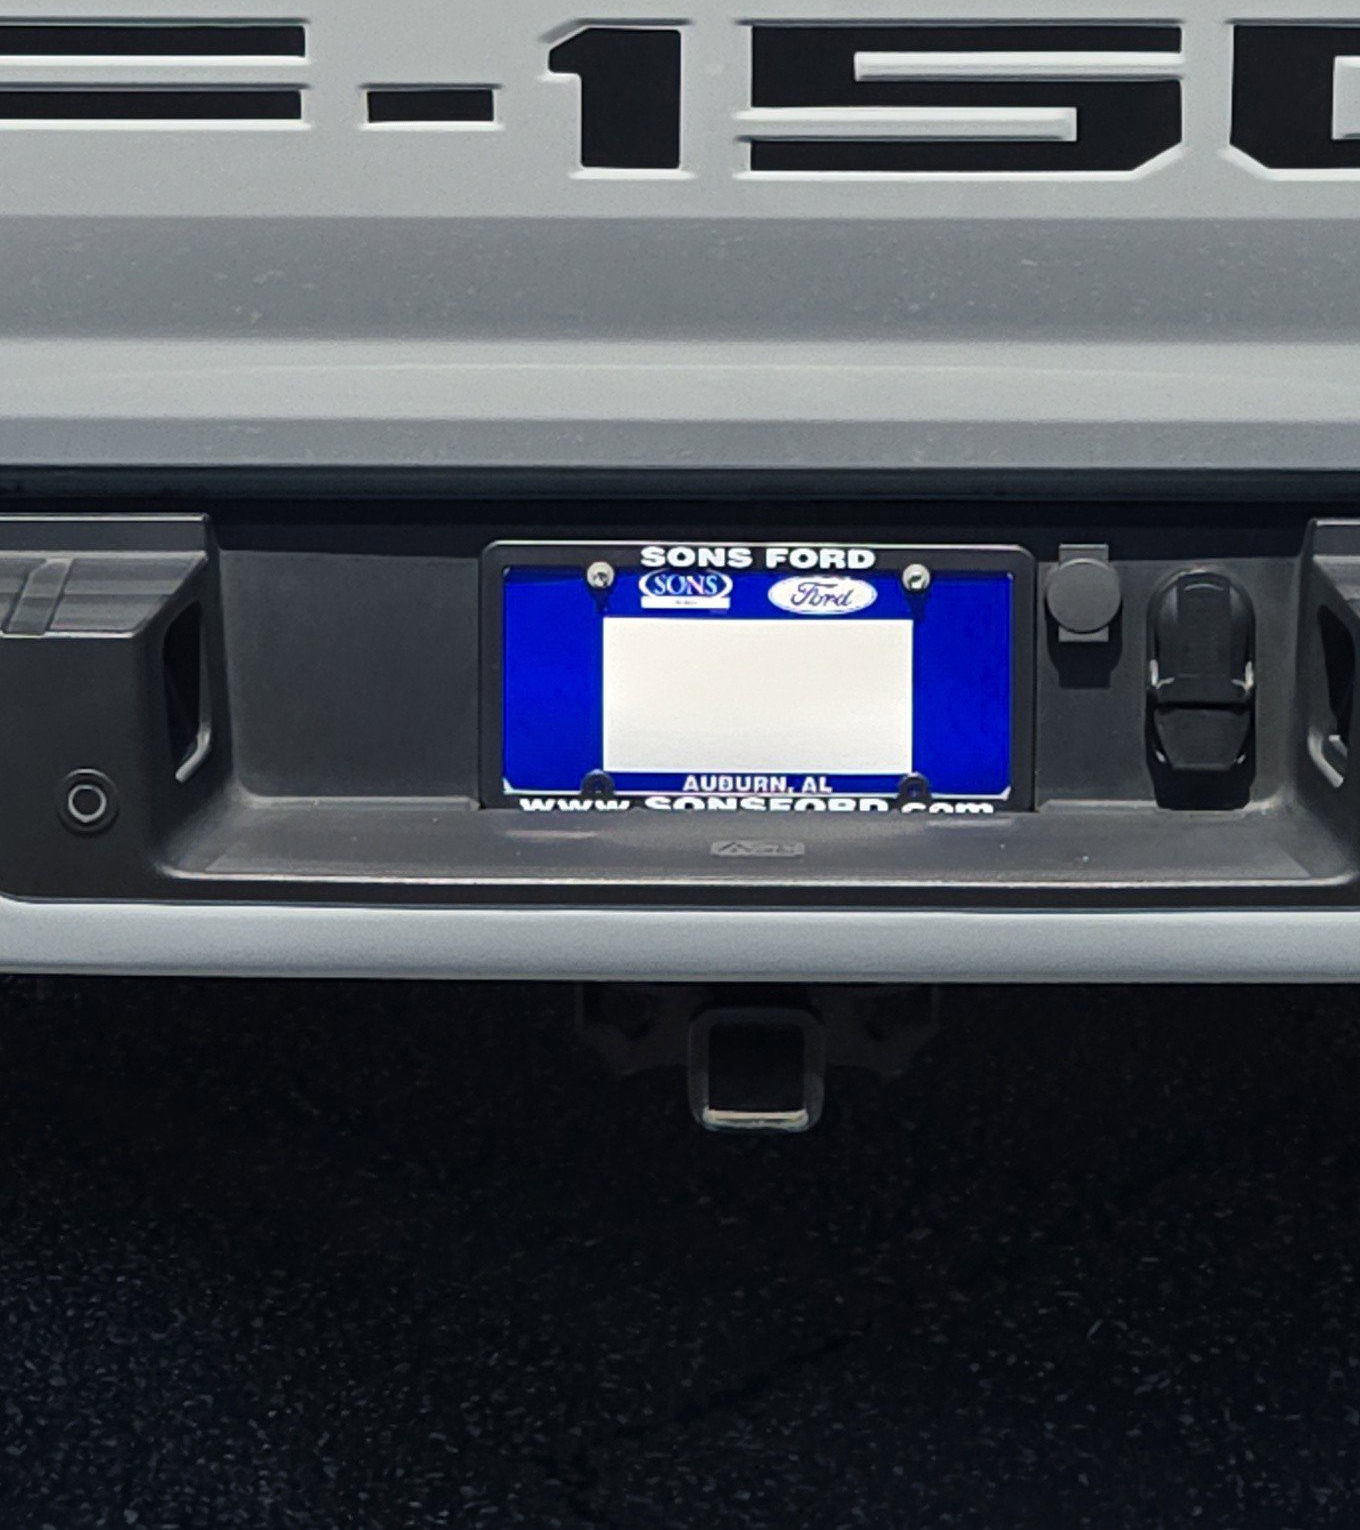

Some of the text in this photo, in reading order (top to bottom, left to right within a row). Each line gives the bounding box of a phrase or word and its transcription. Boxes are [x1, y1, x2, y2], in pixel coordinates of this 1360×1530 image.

[640, 546, 876, 569] SONS FORD
[653, 573, 718, 597] SONS
[789, 581, 856, 608] Ford
[682, 775, 833, 794] AUBURN, AL
